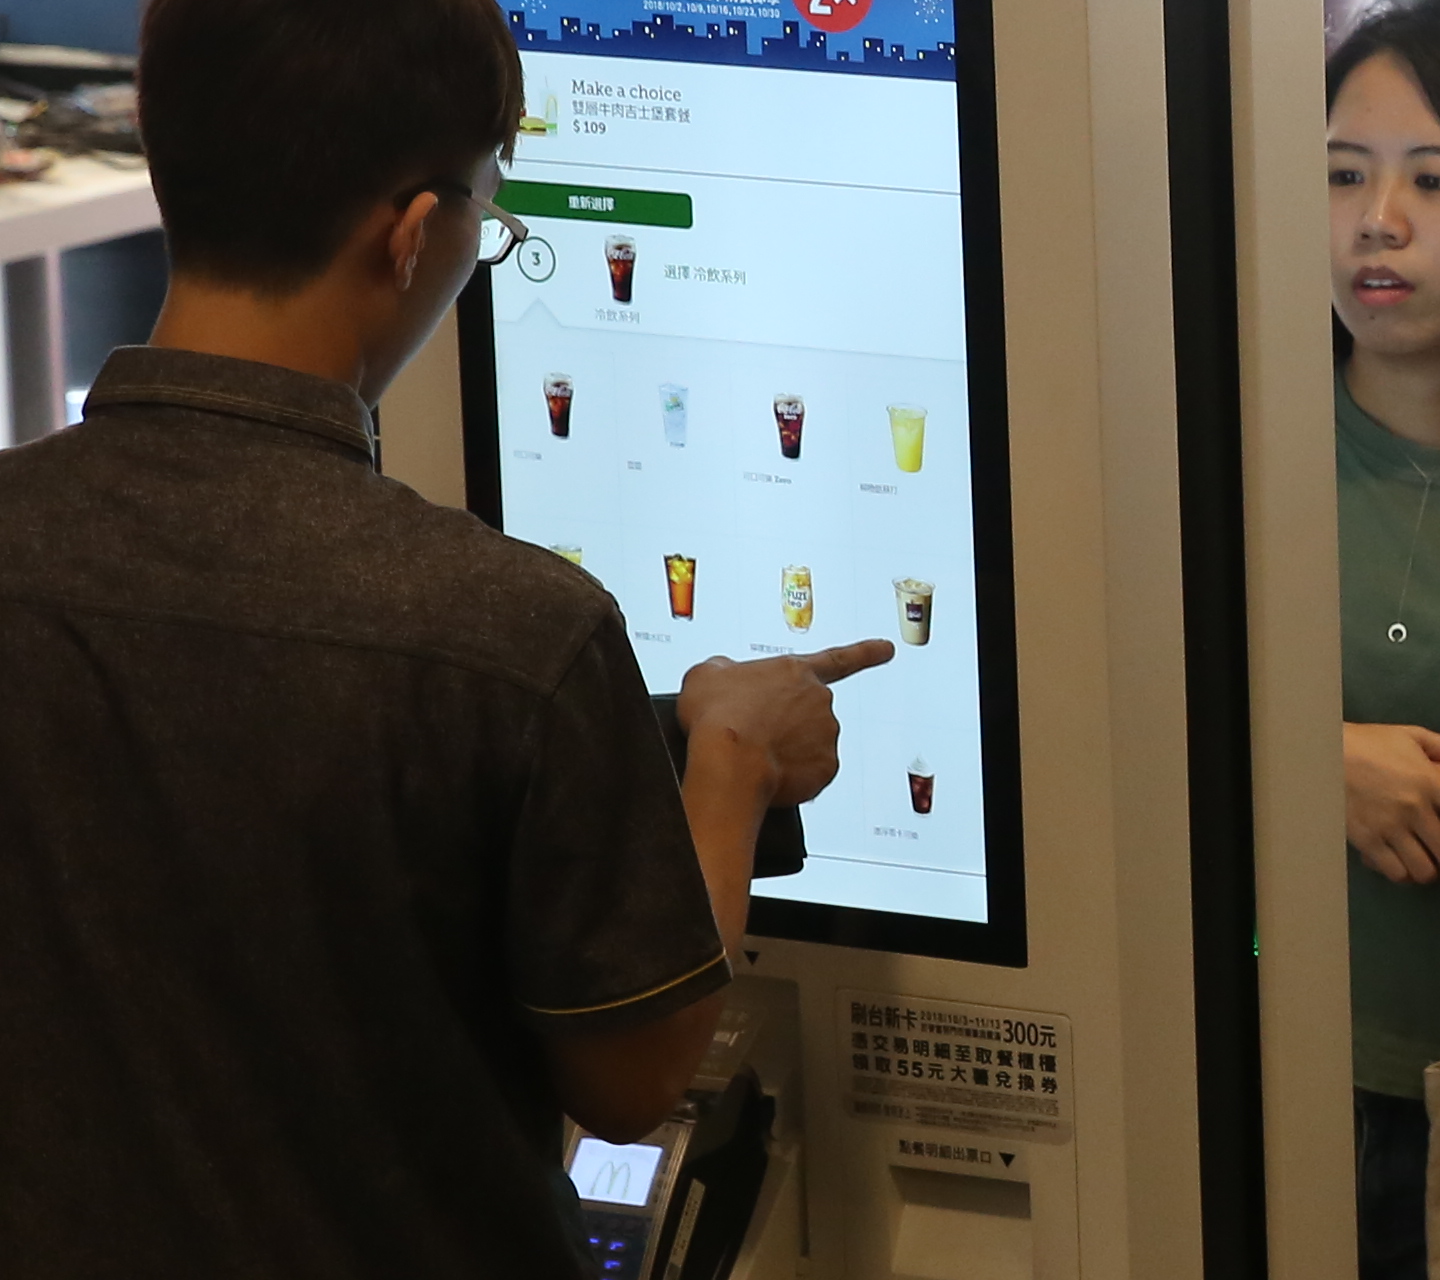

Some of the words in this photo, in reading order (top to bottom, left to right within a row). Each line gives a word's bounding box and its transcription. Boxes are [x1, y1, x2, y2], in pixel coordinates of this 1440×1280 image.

[571, 79, 613, 97] Make
[617, 87, 626, 98] a
[629, 84, 682, 102] choice
[531, 251, 541, 267] 3
[1003, 1019, 1057, 1049] 300元
